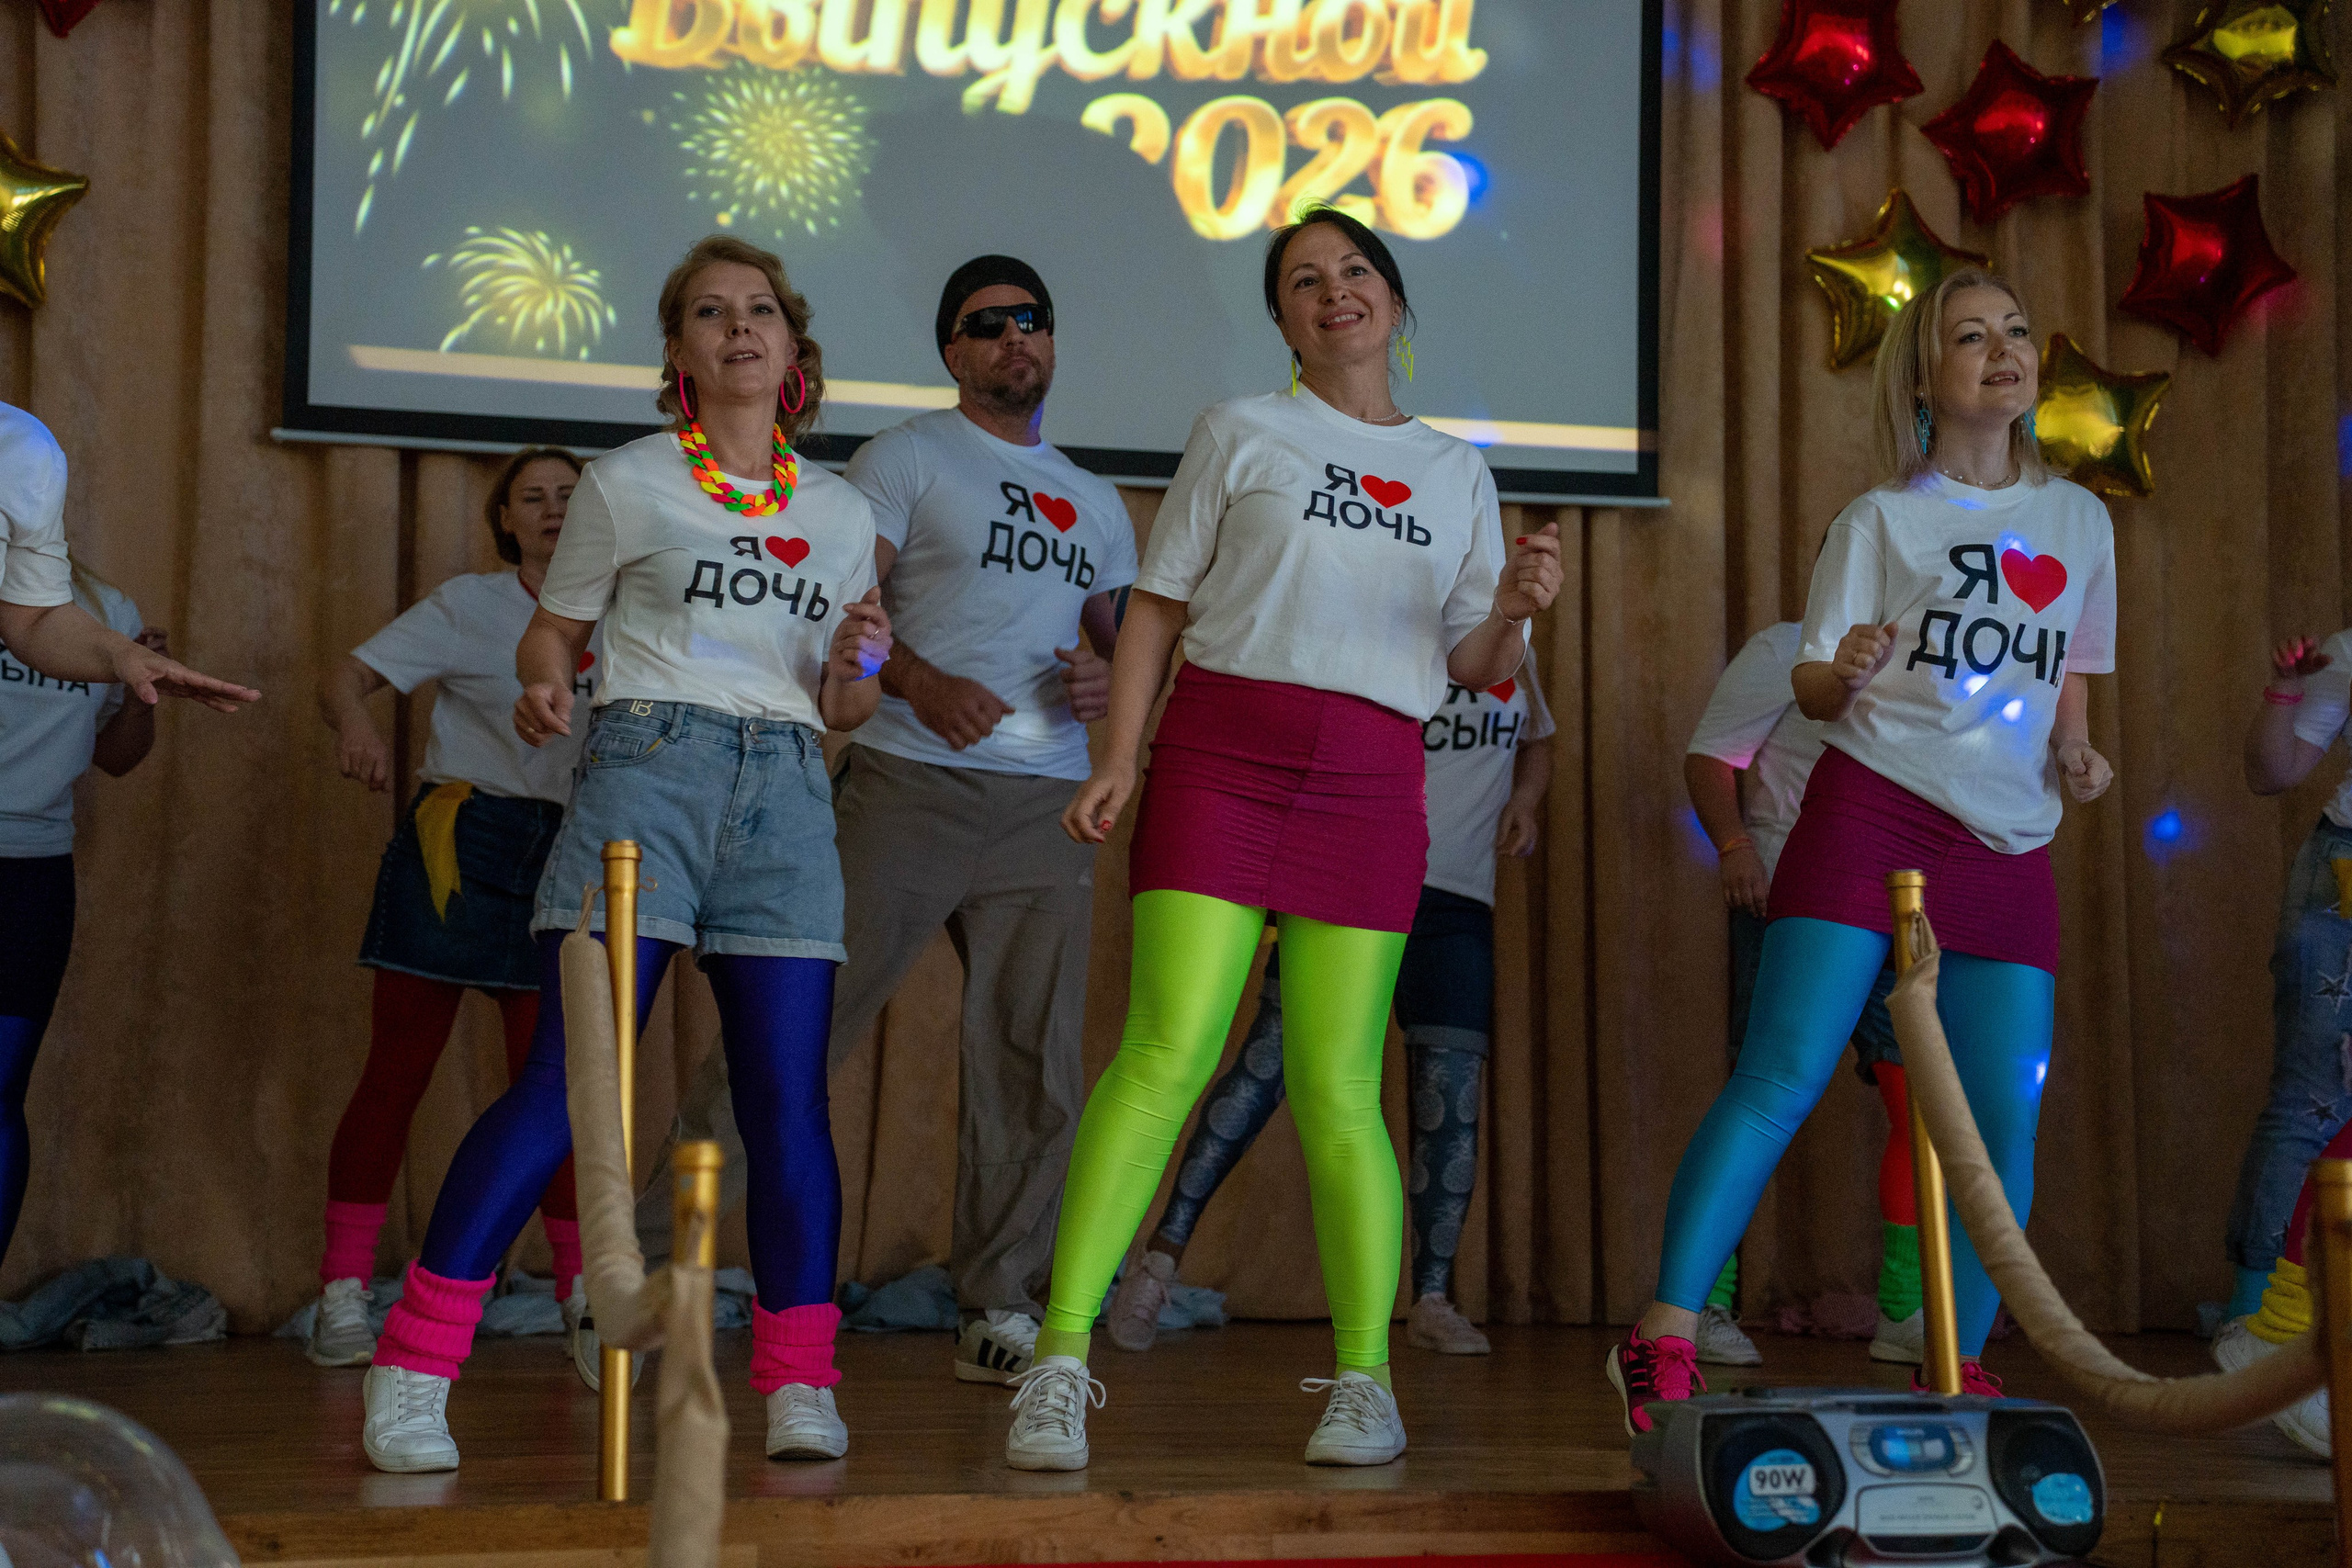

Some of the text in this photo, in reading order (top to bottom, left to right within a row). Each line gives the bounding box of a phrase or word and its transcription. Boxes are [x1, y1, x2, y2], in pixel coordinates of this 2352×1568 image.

[1325, 463, 1359, 496] Я
[1000, 481, 1035, 523] Я
[1303, 490, 1432, 547] ДОЧЬ
[729, 536, 763, 561] Я
[980, 520, 1095, 591] ДОЧЬ
[684, 559, 830, 623] ДОЧЬ
[1949, 544, 1998, 604] Я
[1421, 710, 1527, 751] СЫН
[1755, 1468, 1806, 1489] 90W
